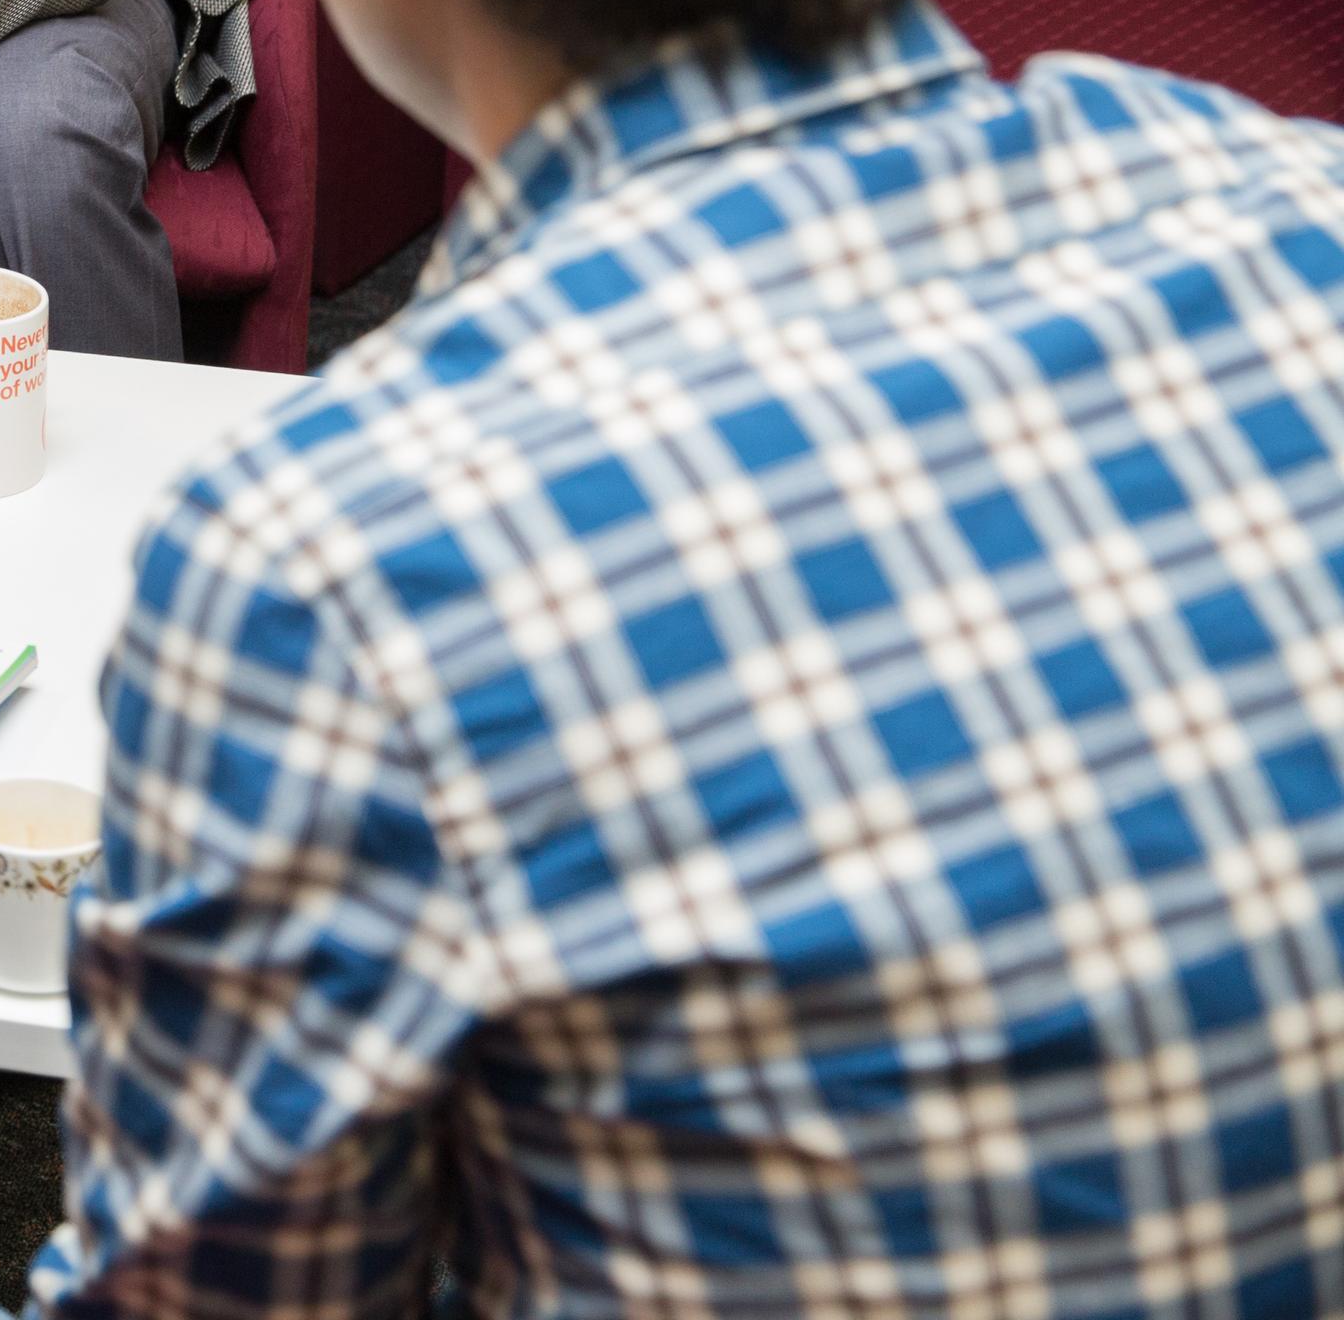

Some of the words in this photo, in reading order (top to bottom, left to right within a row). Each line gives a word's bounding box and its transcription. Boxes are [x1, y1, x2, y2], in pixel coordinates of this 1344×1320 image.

[0, 324, 46, 355] Never
[0, 352, 39, 382] your
[0, 378, 21, 400] of
